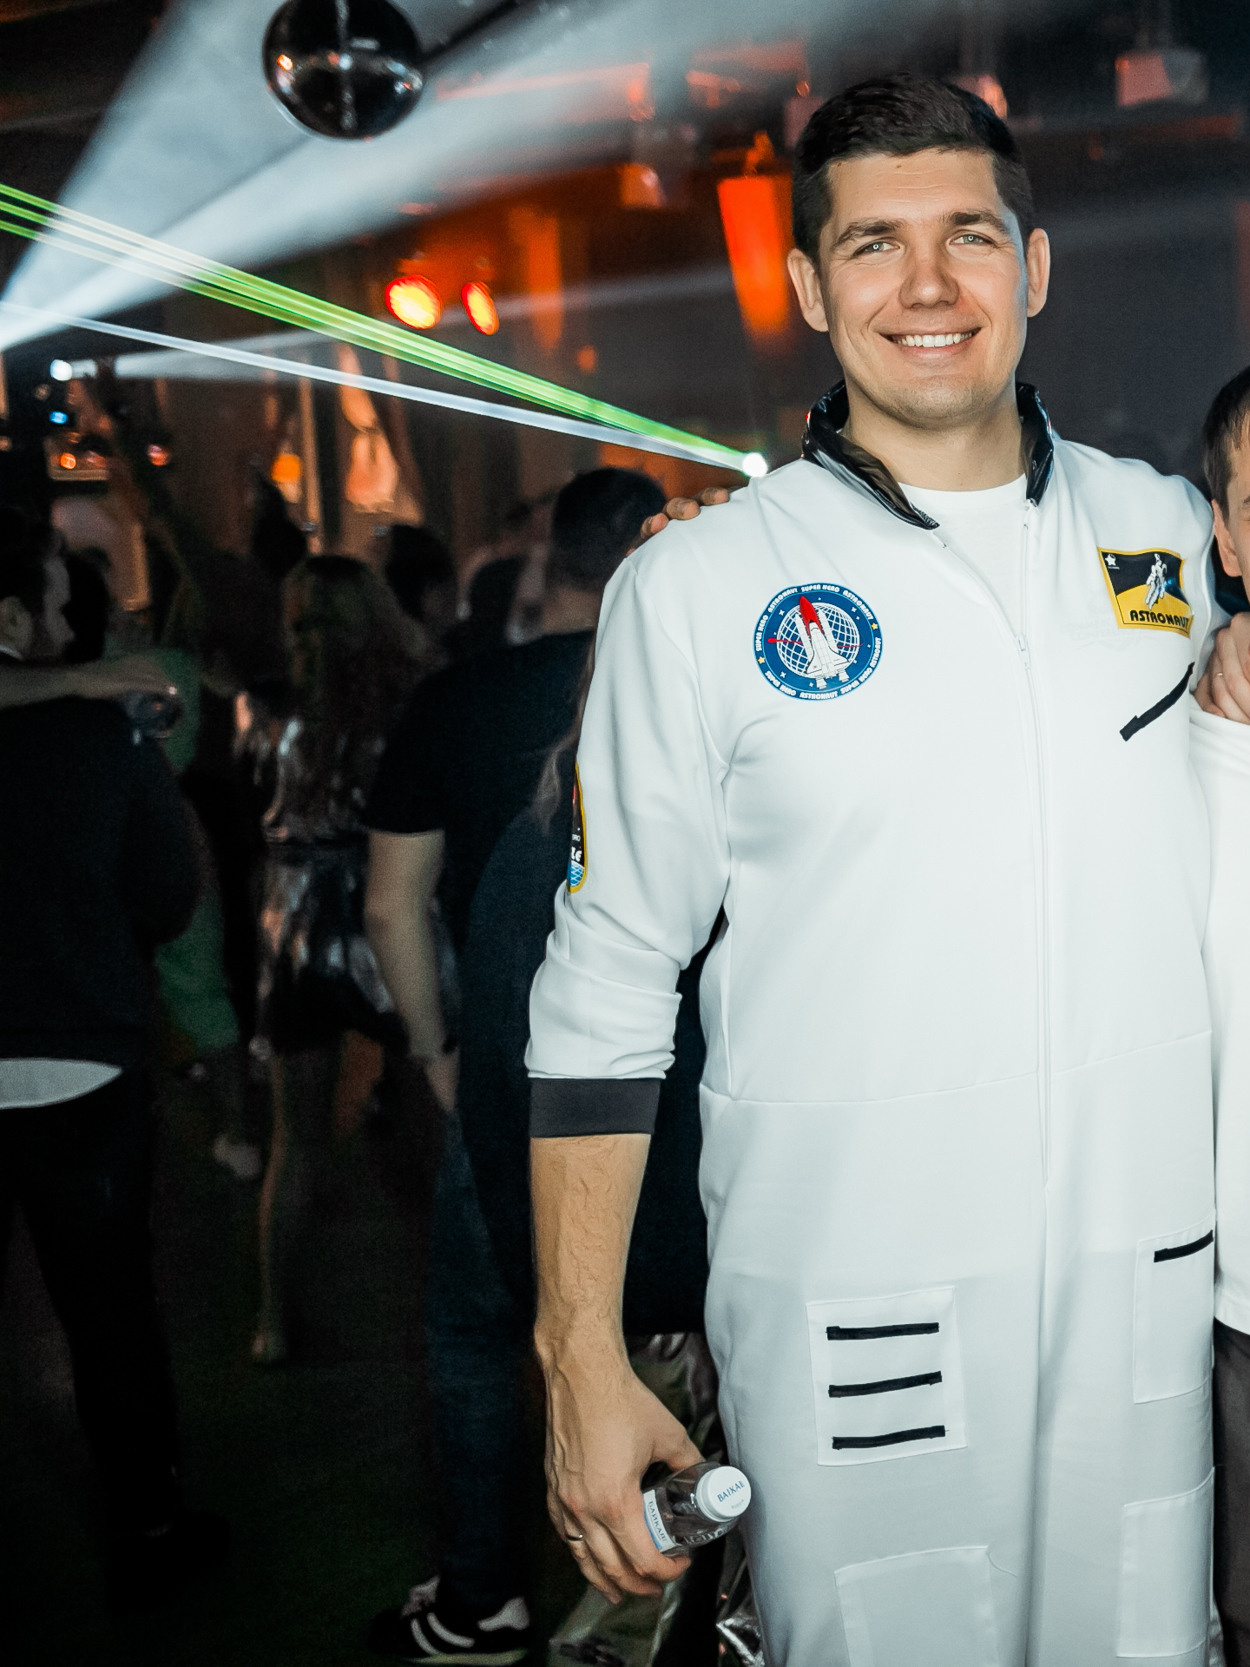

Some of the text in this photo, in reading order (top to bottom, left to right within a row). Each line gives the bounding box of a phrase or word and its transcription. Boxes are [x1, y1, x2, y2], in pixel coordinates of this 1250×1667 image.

[758, 615, 769, 631] HERO
[801, 584, 821, 593] SUPER
[822, 584, 840, 592] HERO
[842, 590, 874, 620] ASTRONAUT
[1130, 610, 1189, 630] ASTRONAUT
[779, 684, 797, 696] HERO
[799, 691, 838, 700] ASTRONAUT
[858, 667, 873, 682] HERO
[716, 1480, 745, 1502] BAIKAL
